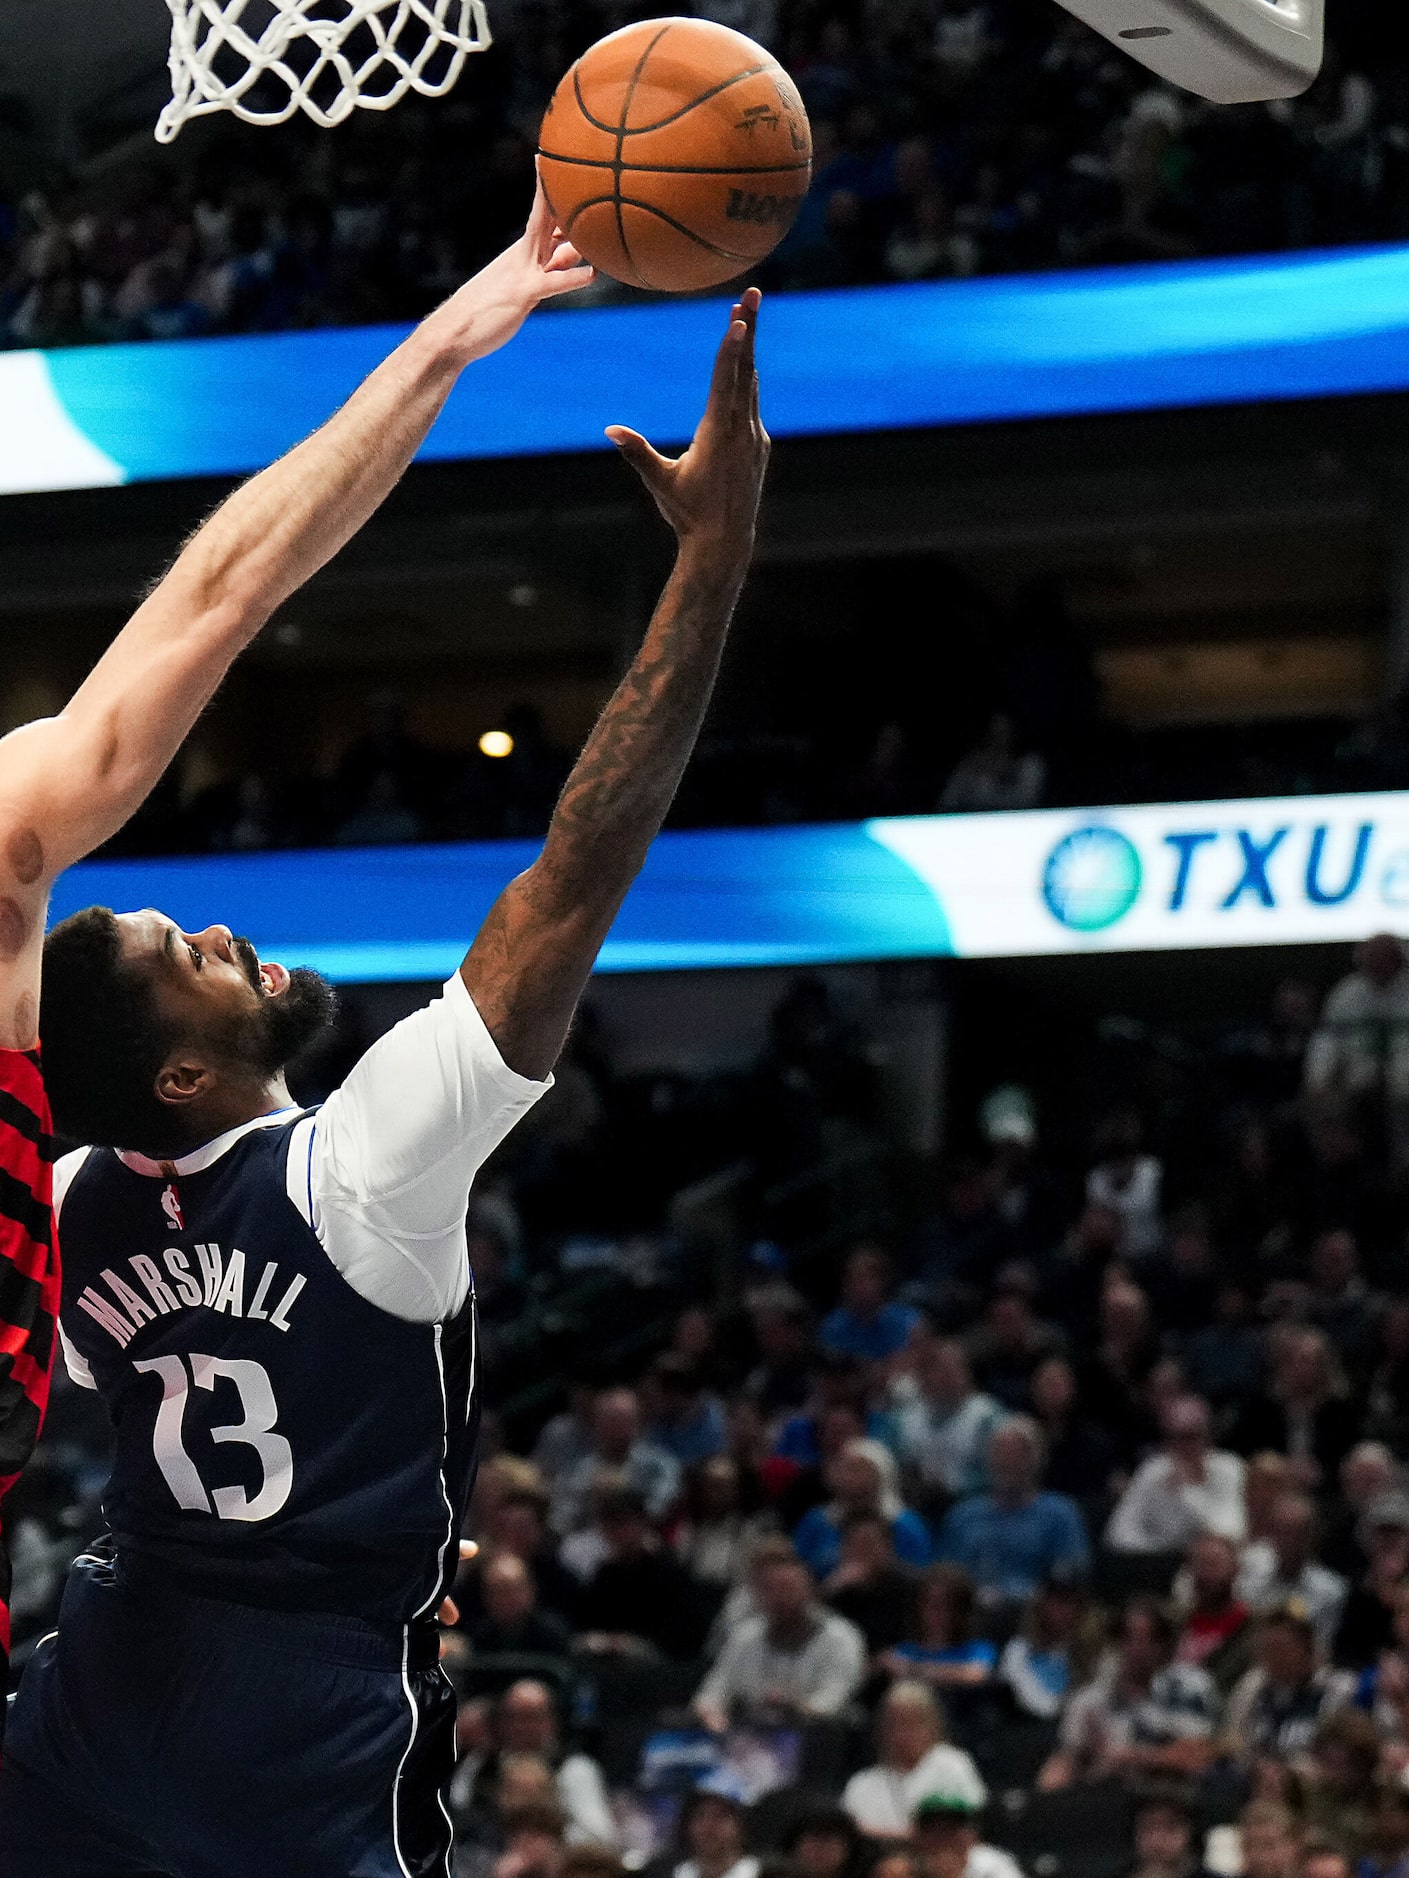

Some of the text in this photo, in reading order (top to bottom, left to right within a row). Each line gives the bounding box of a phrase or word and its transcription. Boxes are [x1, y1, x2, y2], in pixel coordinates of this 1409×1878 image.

[1163, 821, 1374, 911] TXU
[76, 1243, 308, 1350] MARSHALL
[132, 1352, 294, 1523] 13
